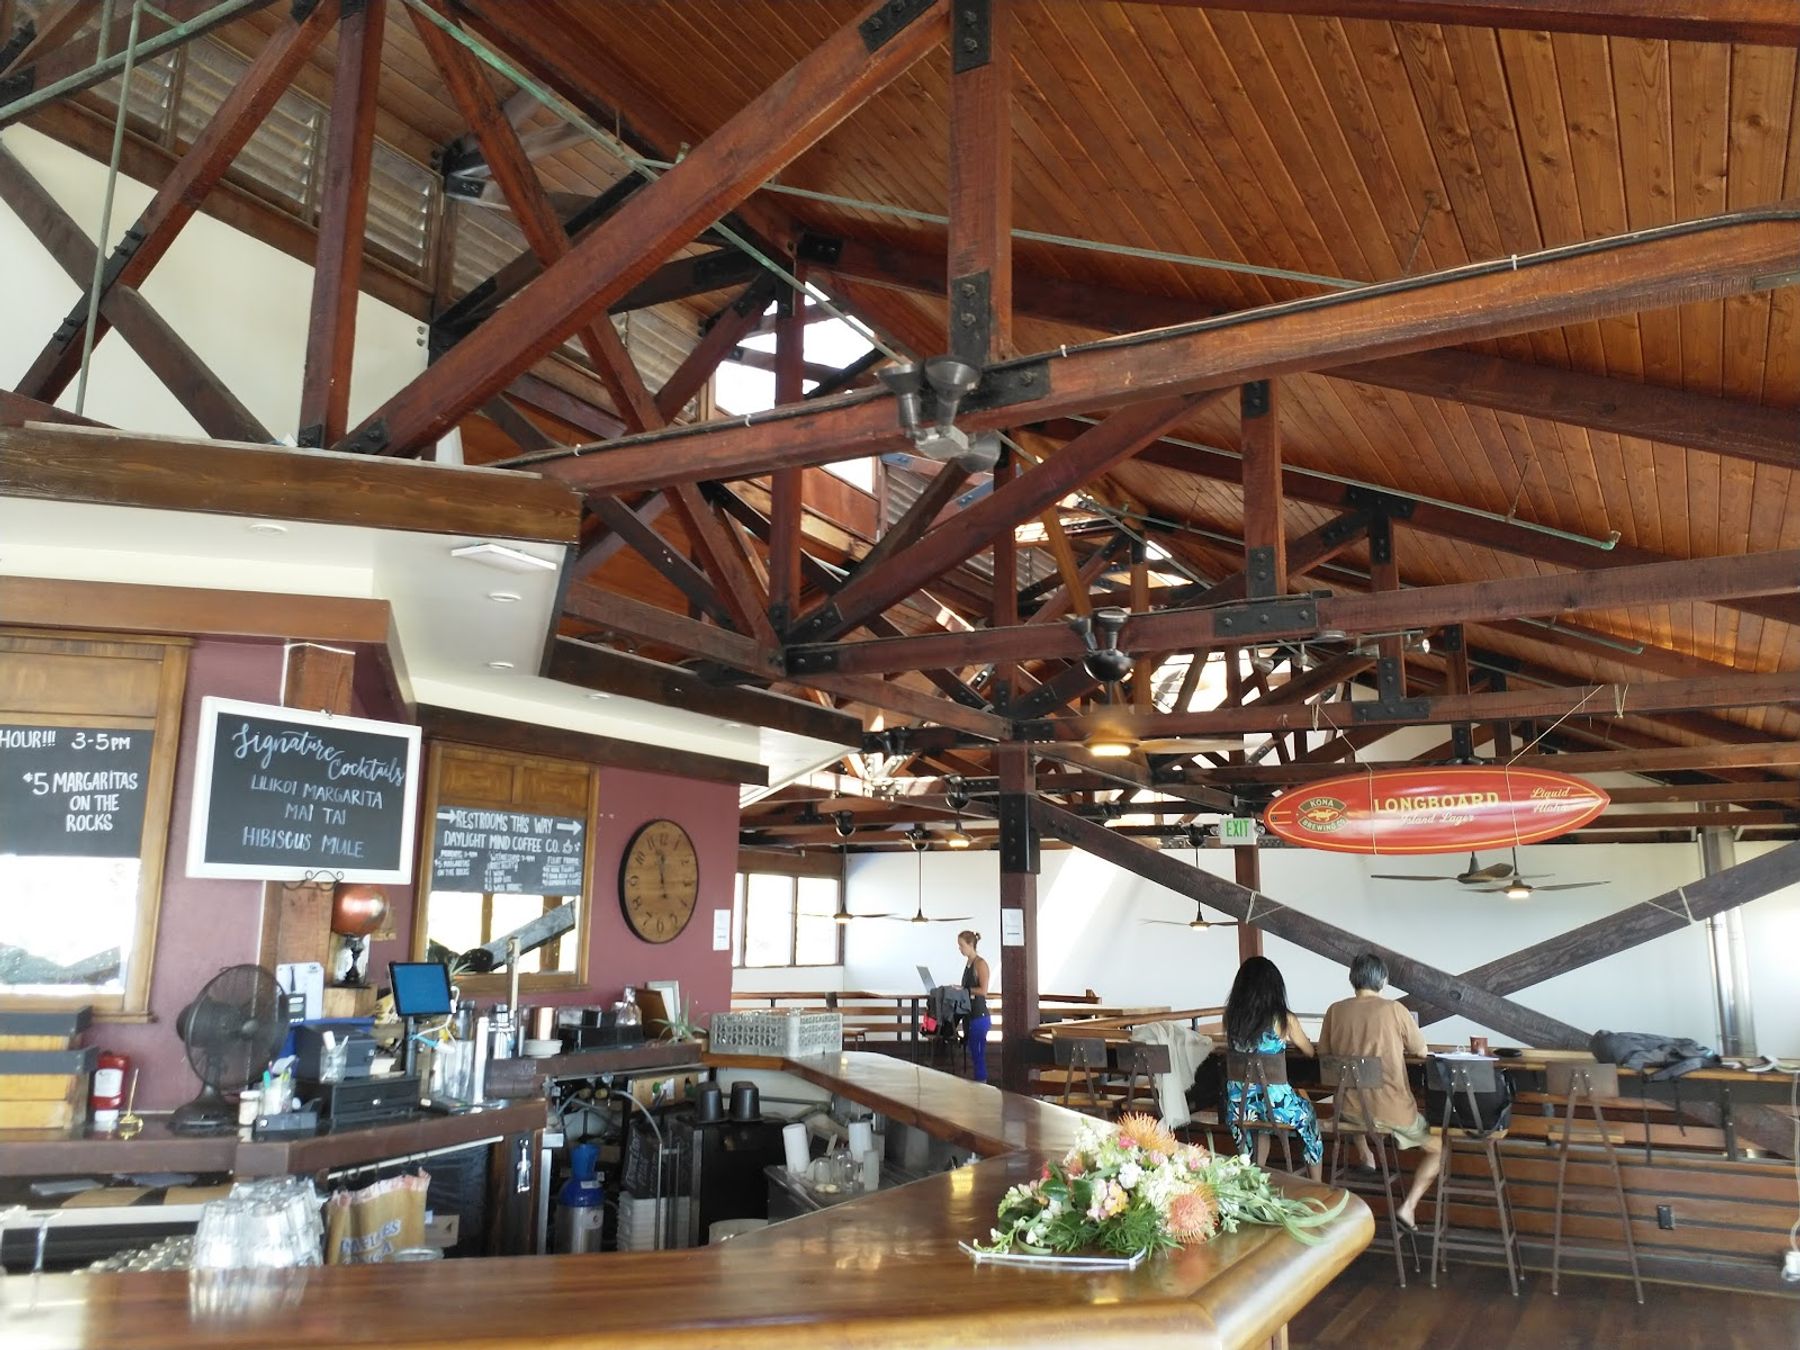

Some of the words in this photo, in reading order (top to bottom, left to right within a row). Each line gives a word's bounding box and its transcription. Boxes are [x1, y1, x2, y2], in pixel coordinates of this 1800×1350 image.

[232, 723, 345, 769] Signature
[327, 756, 406, 787] Cocktails
[52, 770, 138, 793] MARGARITAS
[250, 774, 297, 794] LILIKOI
[302, 783, 383, 809] MARGARITA
[70, 795, 90, 811] ON
[94, 794, 120, 811] THE
[1309, 798, 1334, 808] KONA
[1374, 792, 1499, 813] LONGBOARD
[1530, 786, 1570, 799] Liquid
[66, 814, 113, 832] ROCKS
[284, 803, 314, 821] MAI
[322, 807, 346, 825] TAI
[455, 810, 508, 831] RESTROOMS
[510, 815, 529, 834] THIS
[534, 817, 553, 834] WAY
[1400, 812, 1437, 825] Island
[1439, 811, 1474, 826] Lager
[1226, 819, 1249, 838] EXIT
[1302, 819, 1336, 831] BREWING
[242, 826, 311, 851] HIBISCUS
[321, 835, 365, 858] MULE
[444, 831, 486, 848] DAYLIGHT
[489, 834, 510, 850] MIND
[512, 837, 542, 853] COFFEE
